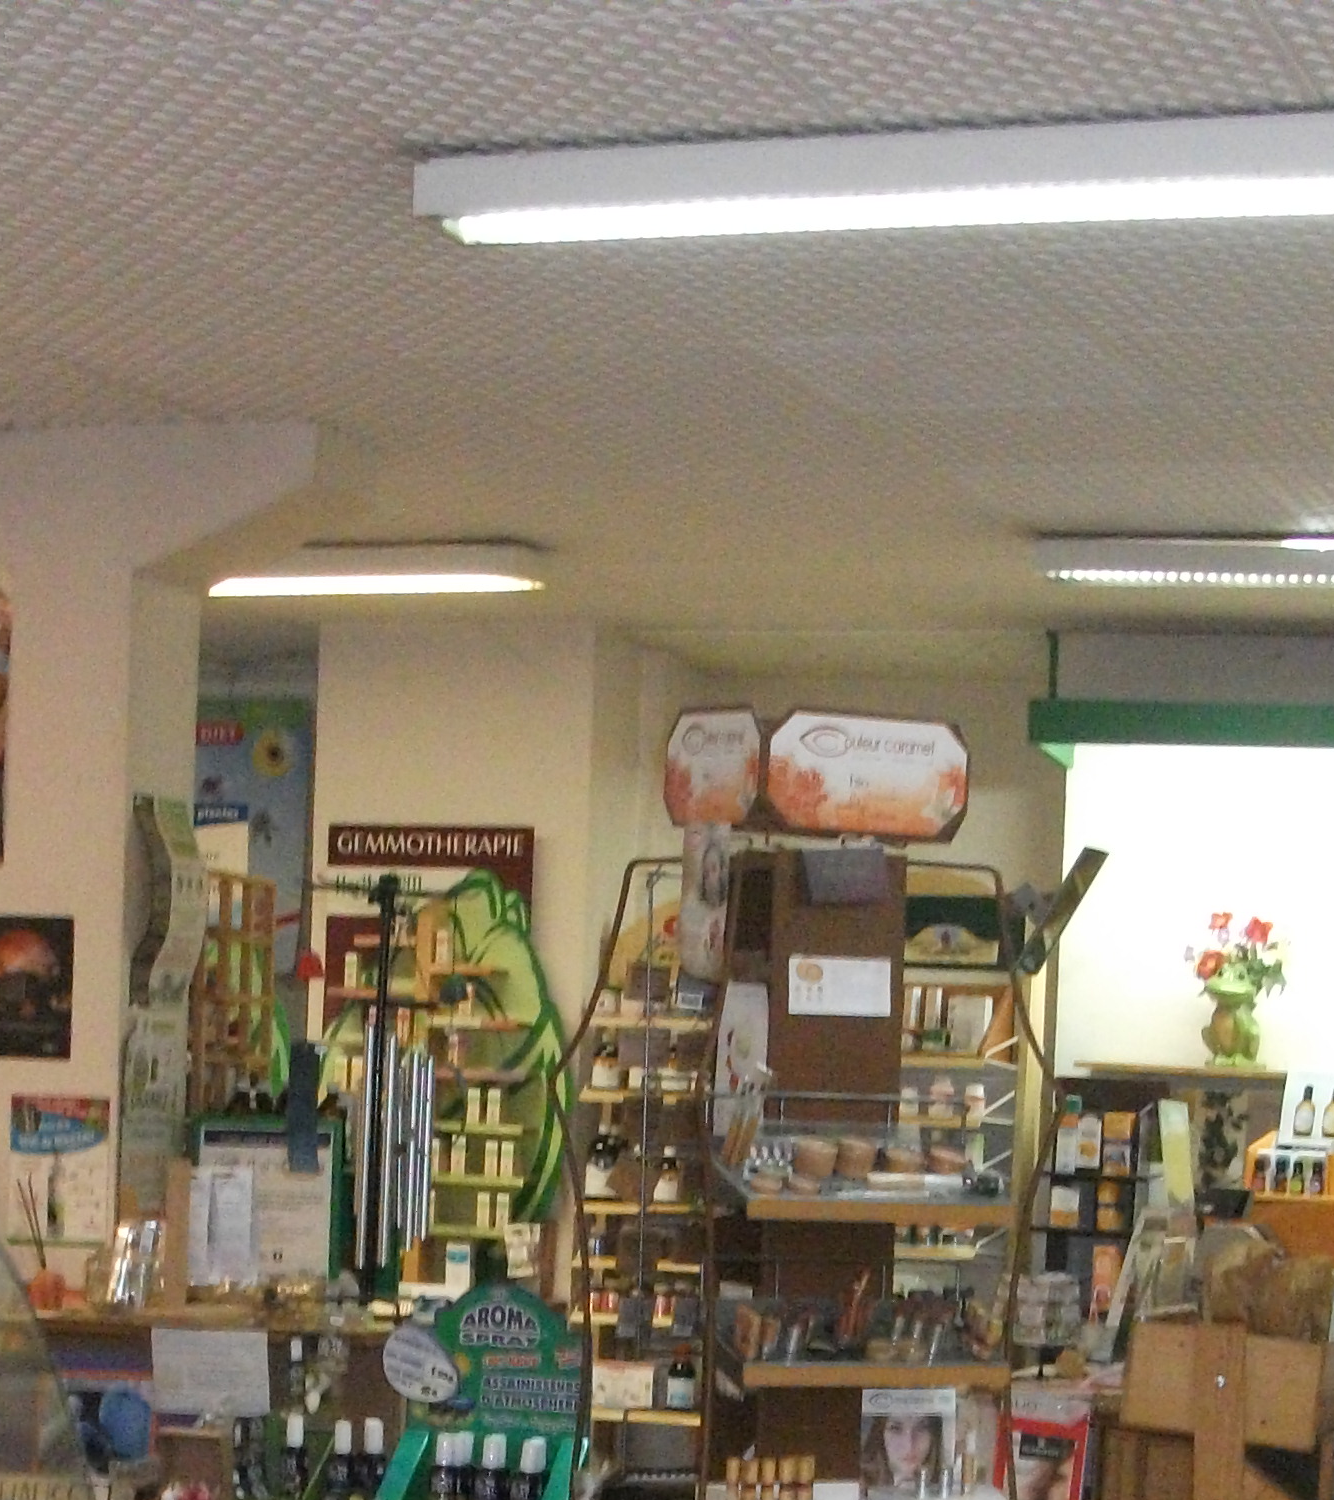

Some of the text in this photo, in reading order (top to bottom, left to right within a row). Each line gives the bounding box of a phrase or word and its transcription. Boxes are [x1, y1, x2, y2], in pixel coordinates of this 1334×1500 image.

[336, 830, 525, 858] GEMMOTHERAPIE
[461, 1304, 538, 1331] AROMA
[459, 1330, 540, 1348] SPRAY
